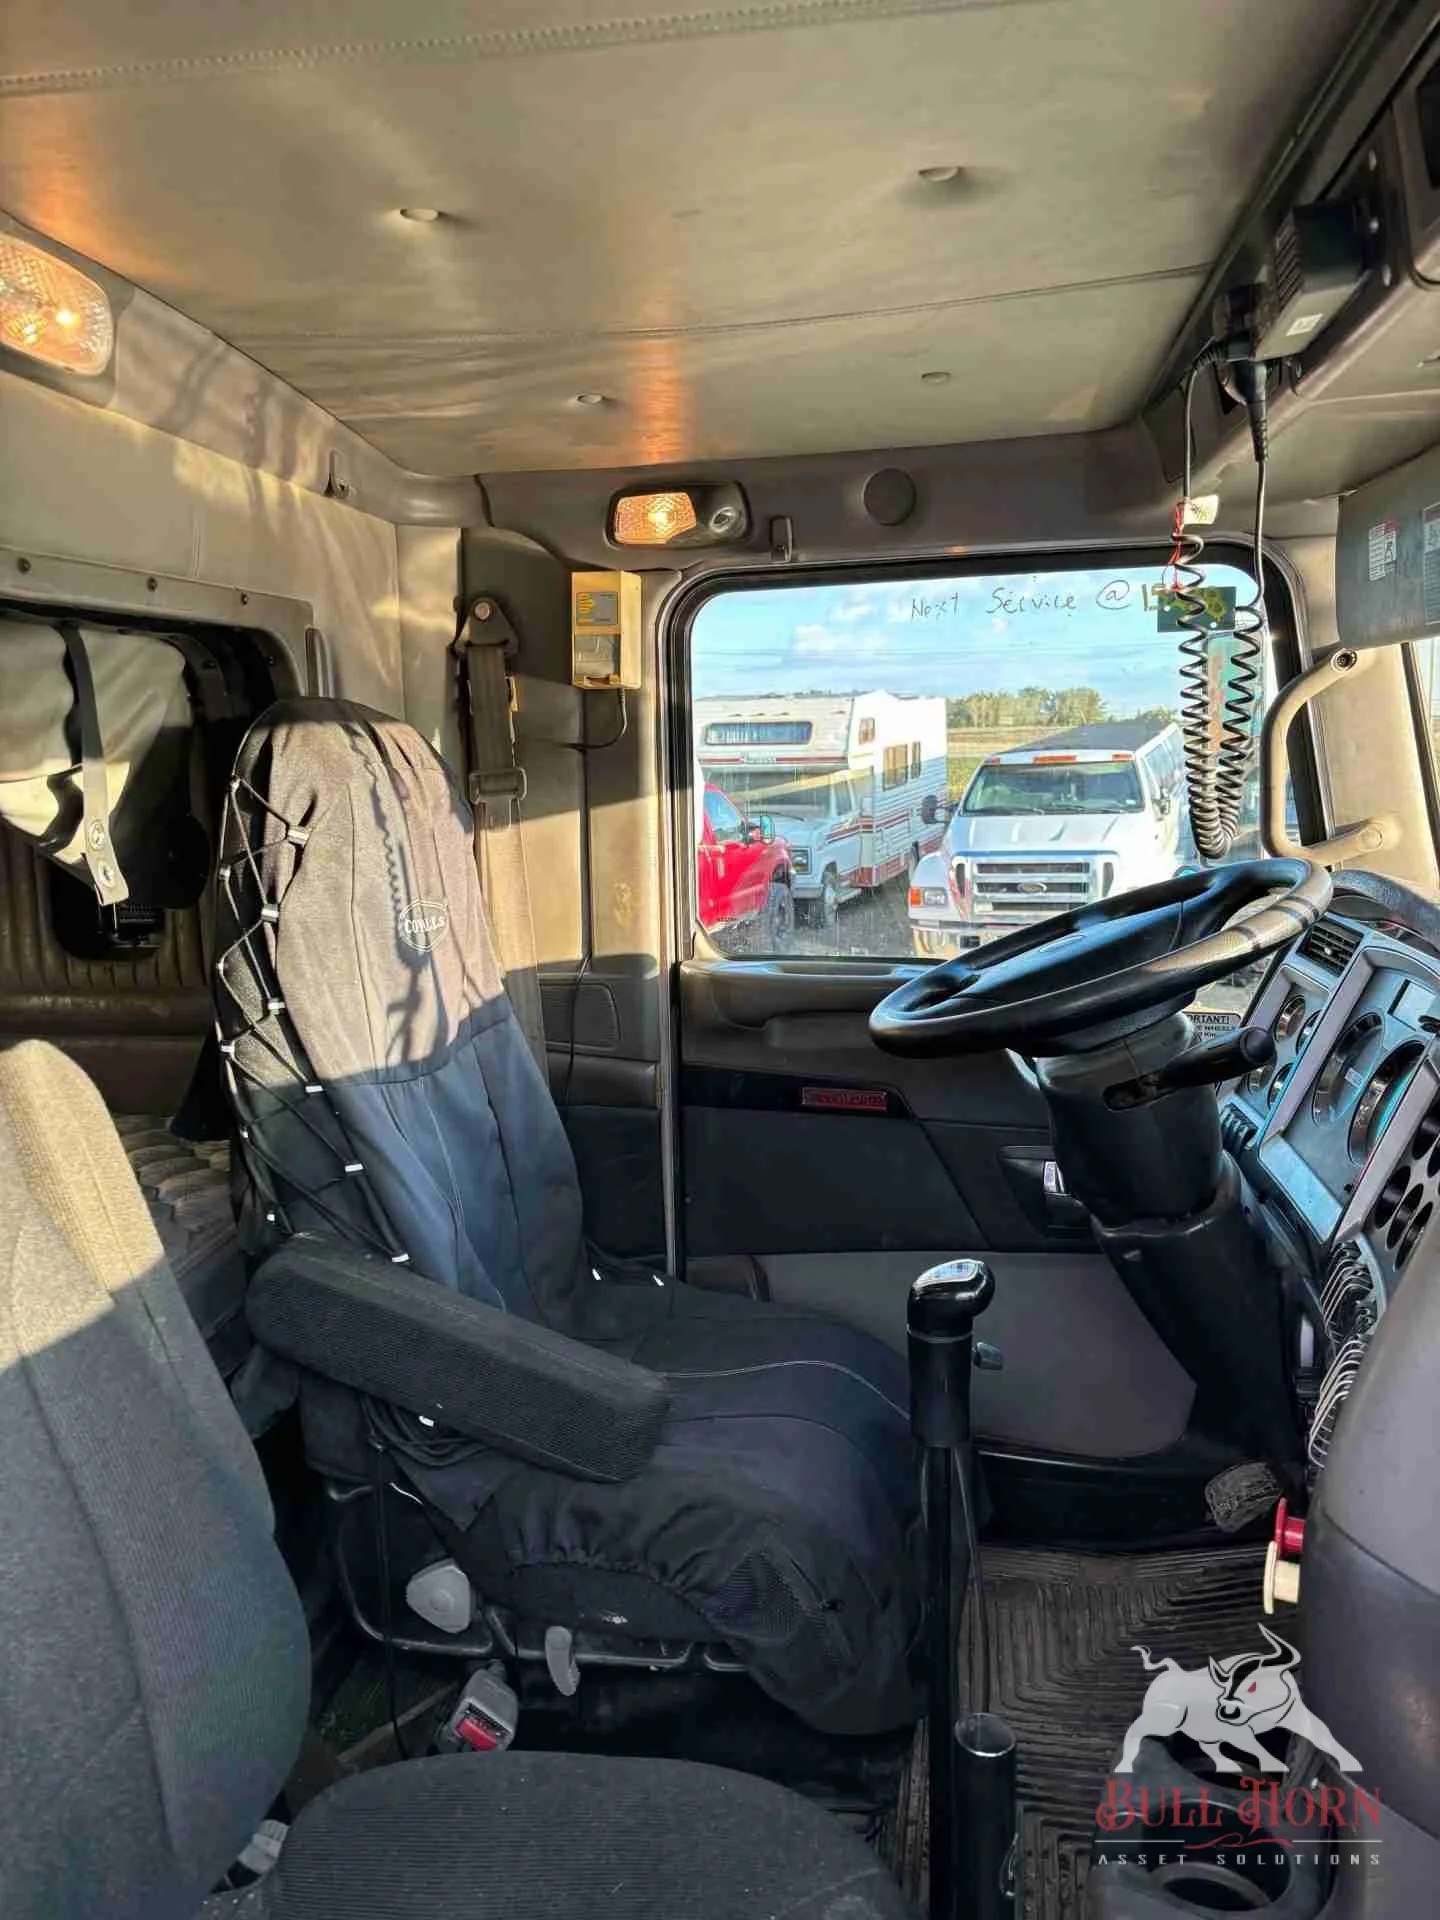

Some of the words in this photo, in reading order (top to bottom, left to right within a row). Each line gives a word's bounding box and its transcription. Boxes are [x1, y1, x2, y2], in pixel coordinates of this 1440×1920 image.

[911, 592, 959, 617] Next
[985, 587, 1077, 614] Service
[1095, 580, 1131, 610] @
[1186, 1014, 1230, 1025] ORTANT!
